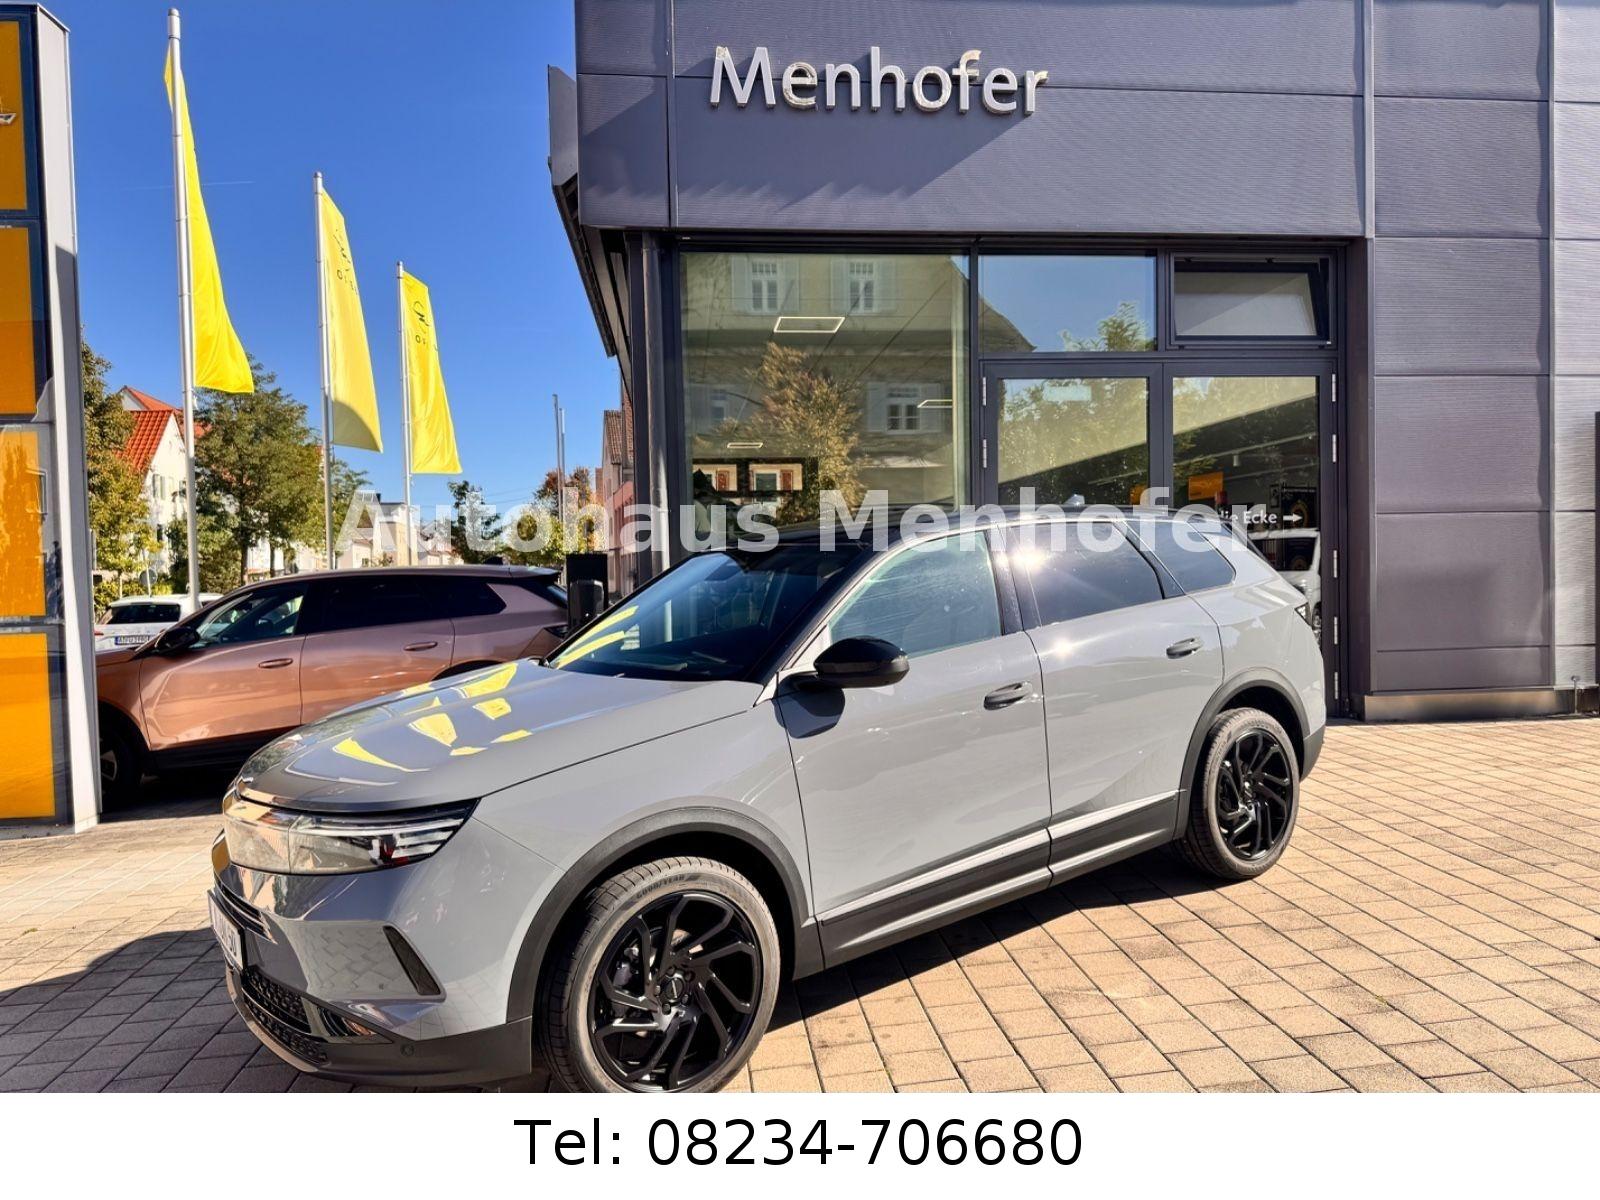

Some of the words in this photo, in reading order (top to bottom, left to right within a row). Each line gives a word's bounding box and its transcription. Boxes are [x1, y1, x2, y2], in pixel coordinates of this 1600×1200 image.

[709, 45, 1049, 116] Menhofer
[1242, 509, 1278, 525] Ecke
[636, 875, 686, 899] GOODYEAR
